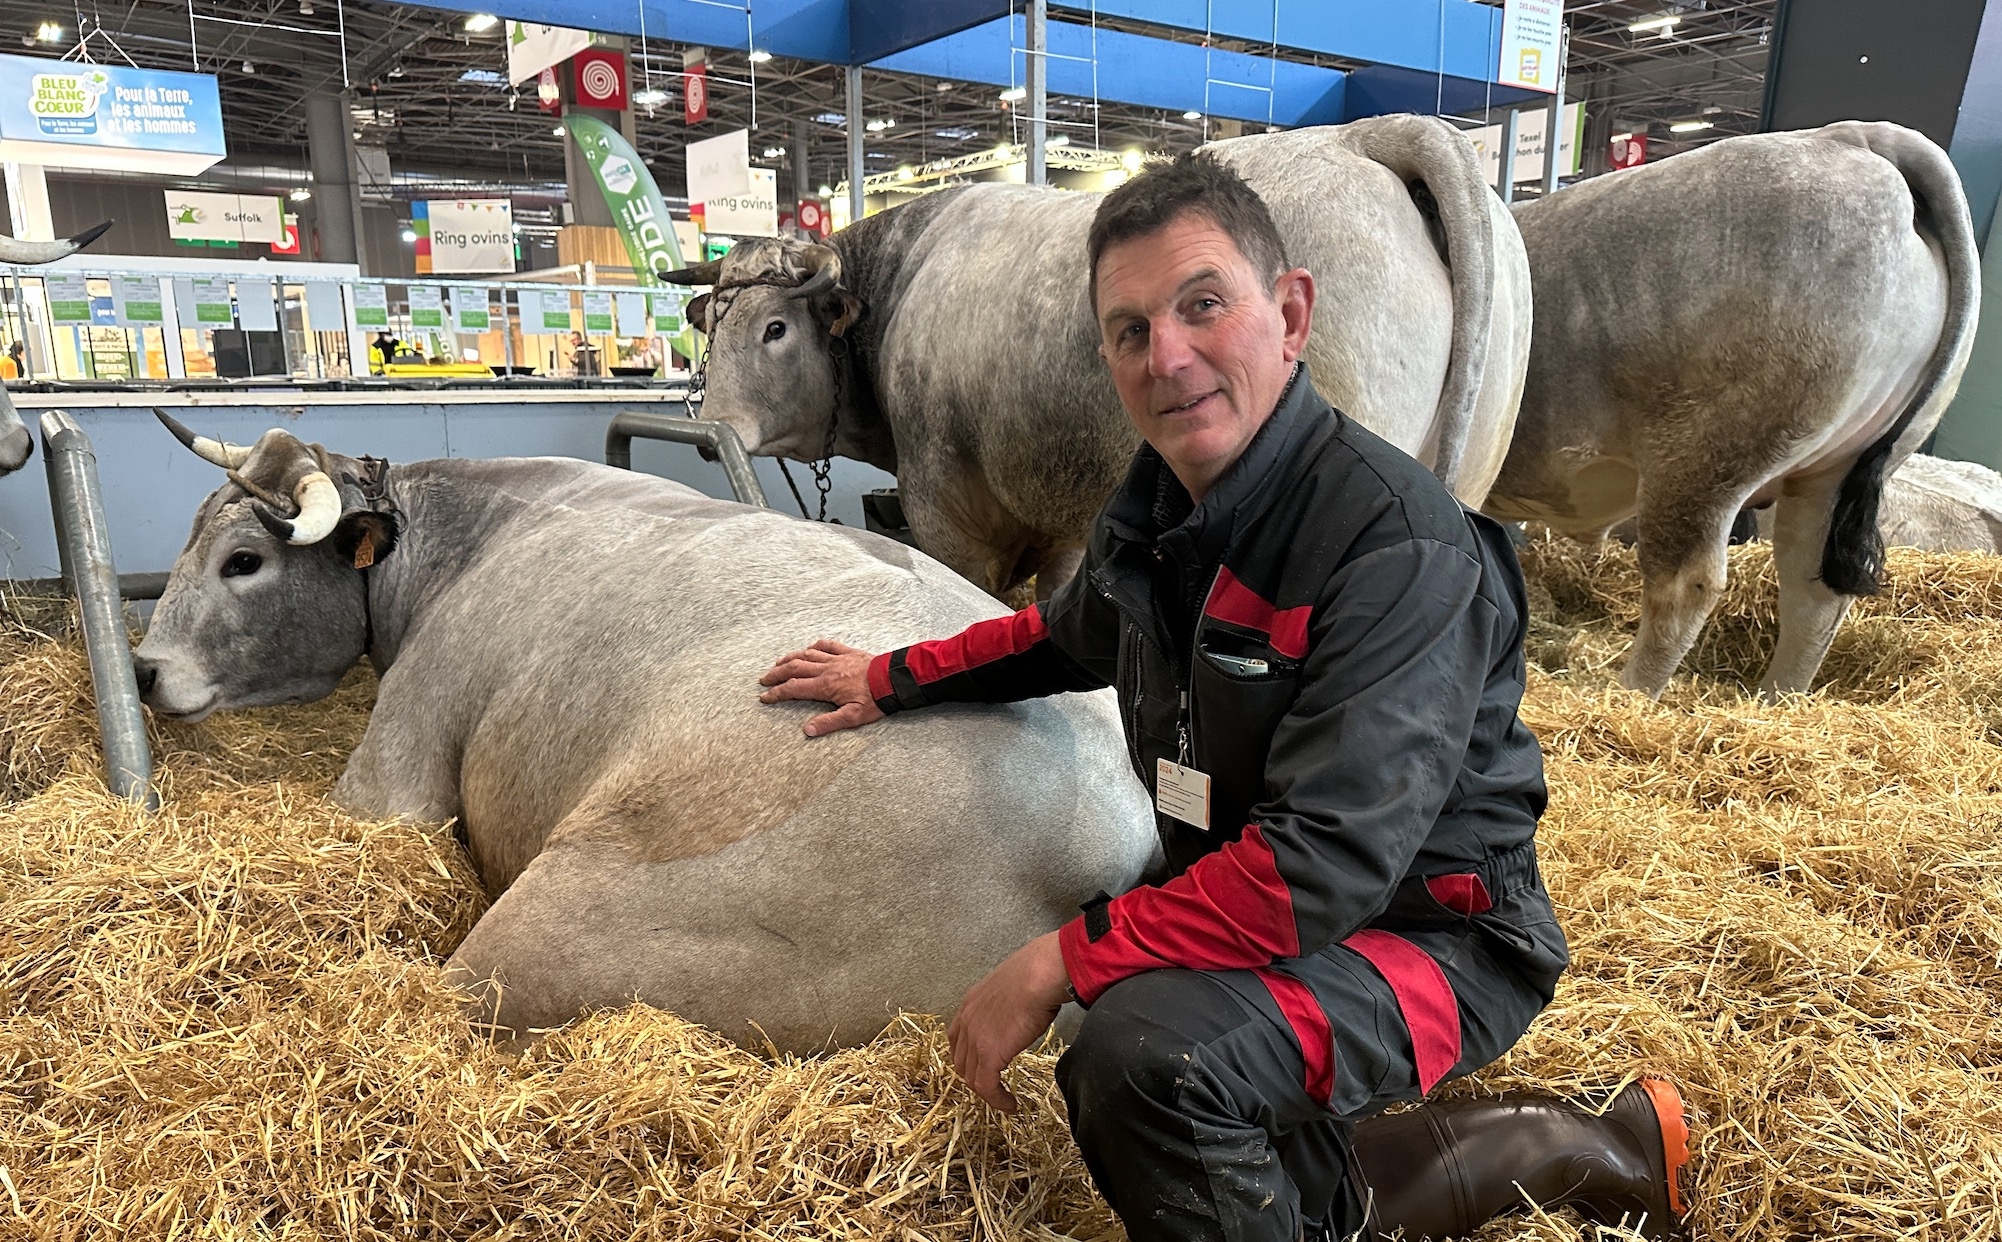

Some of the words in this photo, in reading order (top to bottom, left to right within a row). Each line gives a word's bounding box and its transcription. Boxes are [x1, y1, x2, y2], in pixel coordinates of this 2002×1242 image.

[41, 78, 76, 89] BLEU
[38, 89, 86, 101] BLANC
[115, 86, 143, 102] Pour
[145, 87, 158, 103] la
[158, 88, 193, 105] Terre,
[111, 101, 131, 117] les
[133, 101, 185, 118] animaux
[107, 117, 121, 133] et
[122, 117, 143, 133] les
[144, 118, 196, 134] hommes
[1520, 131, 1541, 143] Texel
[741, 196, 774, 211] ovins
[224, 212, 263, 223] Suffolk
[434, 230, 467, 248] Ring
[471, 229, 509, 244] ovins
[1159, 764, 1172, 775] 2024
